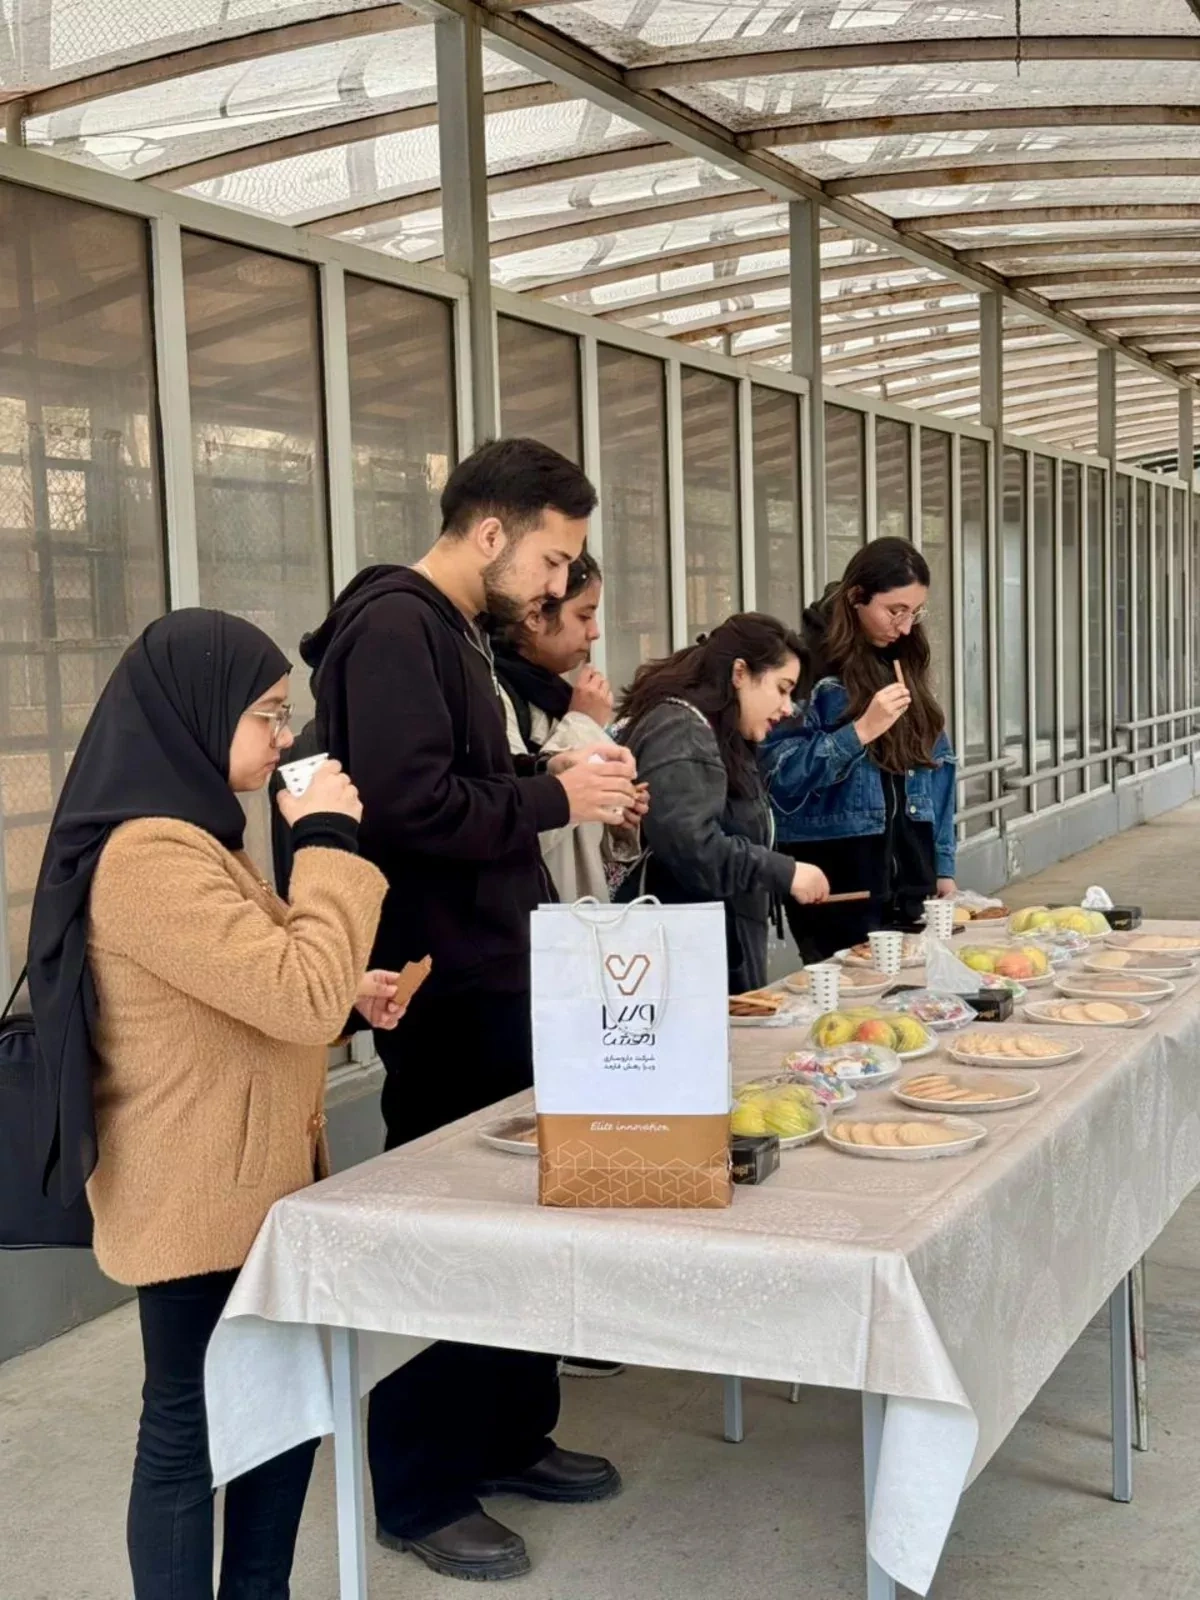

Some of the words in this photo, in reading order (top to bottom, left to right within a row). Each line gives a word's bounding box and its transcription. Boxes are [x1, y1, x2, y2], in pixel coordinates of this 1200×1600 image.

[604, 1054, 633, 1063] داروسازی
[635, 1053, 656, 1063] شرکت
[590, 1119, 613, 1131] Elite
[615, 1119, 670, 1132] innovation
